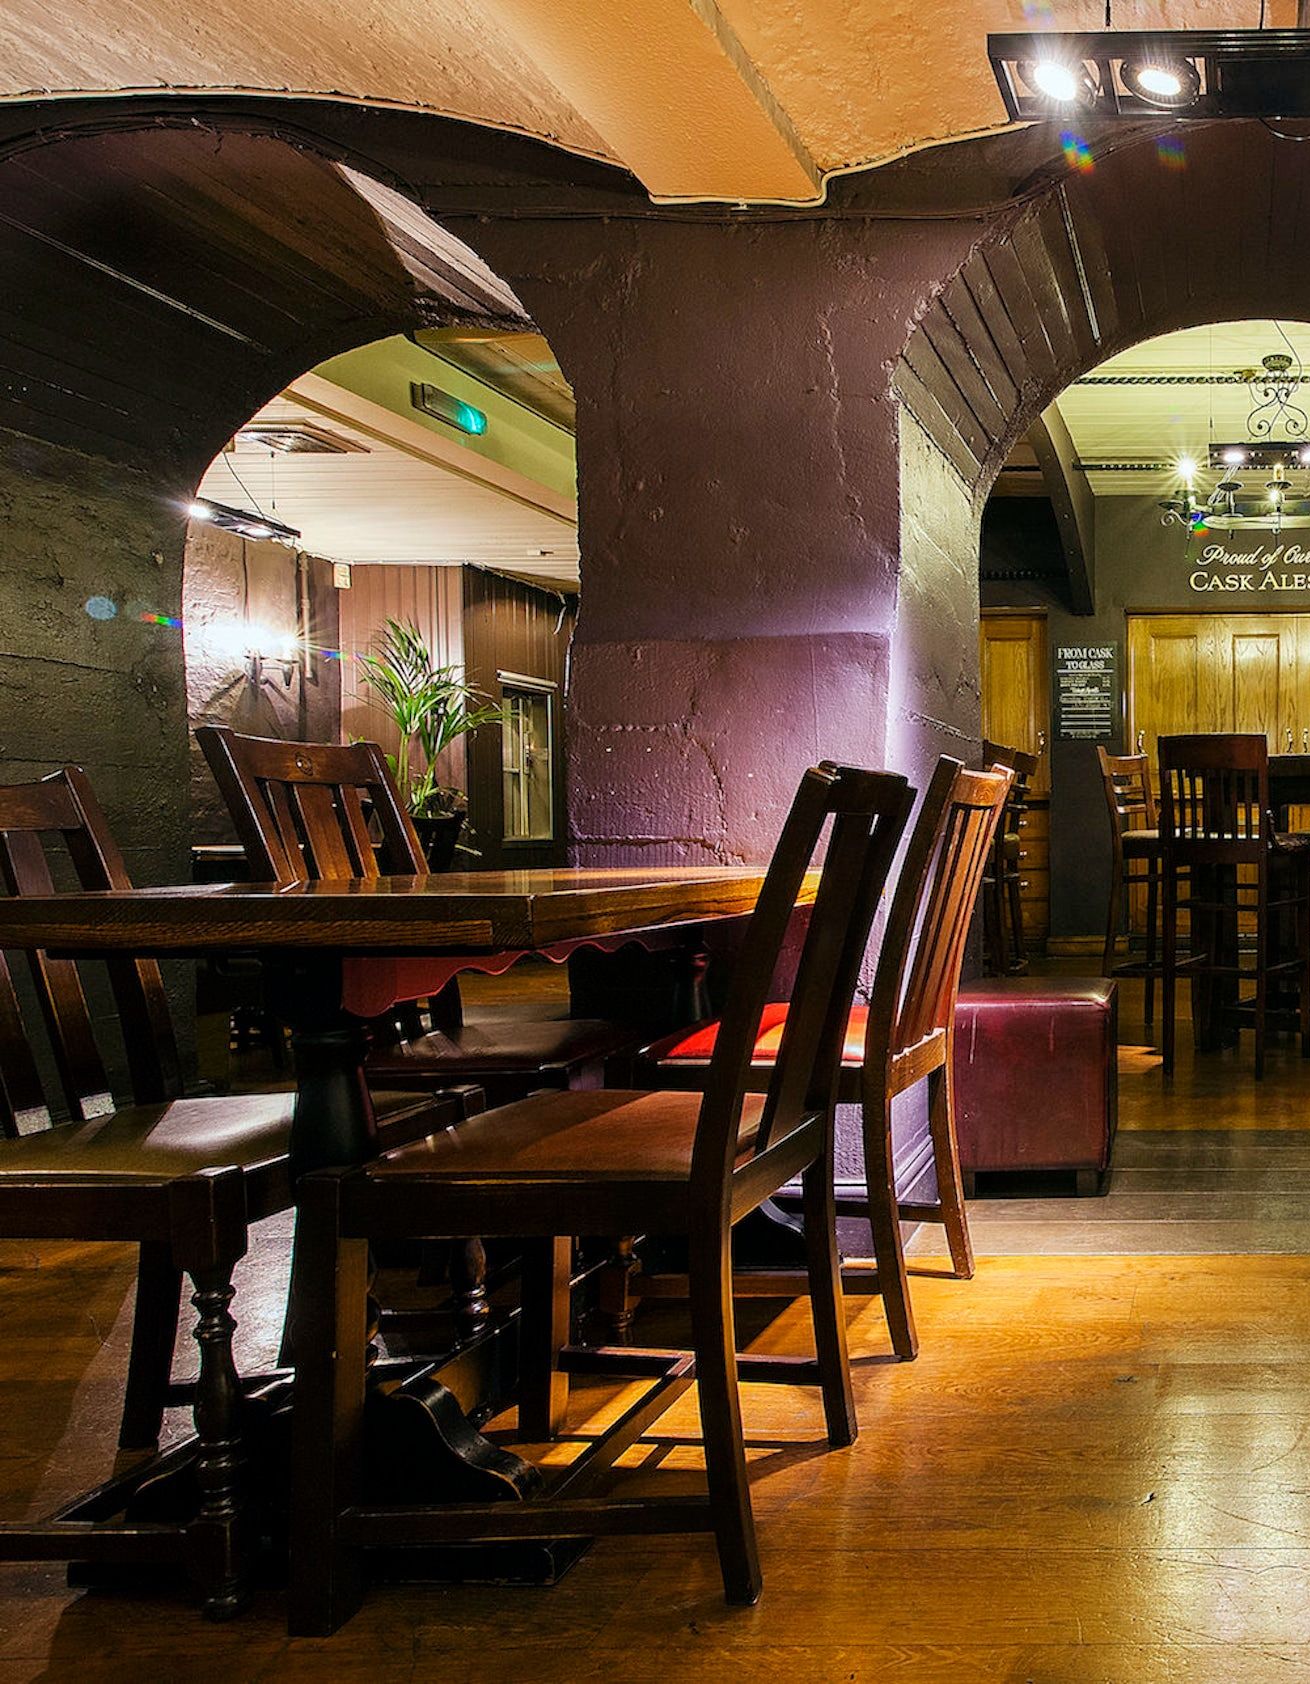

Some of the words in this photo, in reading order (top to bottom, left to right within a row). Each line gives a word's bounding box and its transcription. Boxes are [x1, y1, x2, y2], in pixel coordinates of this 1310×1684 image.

[1196, 544, 1265, 566] Proud
[1259, 545, 1285, 571] of
[1189, 571, 1255, 592] CASK
[1057, 647, 1087, 660] FROM
[1088, 647, 1114, 659] CASK
[1066, 660, 1078, 670] TO
[1079, 660, 1105, 670] GLASS
